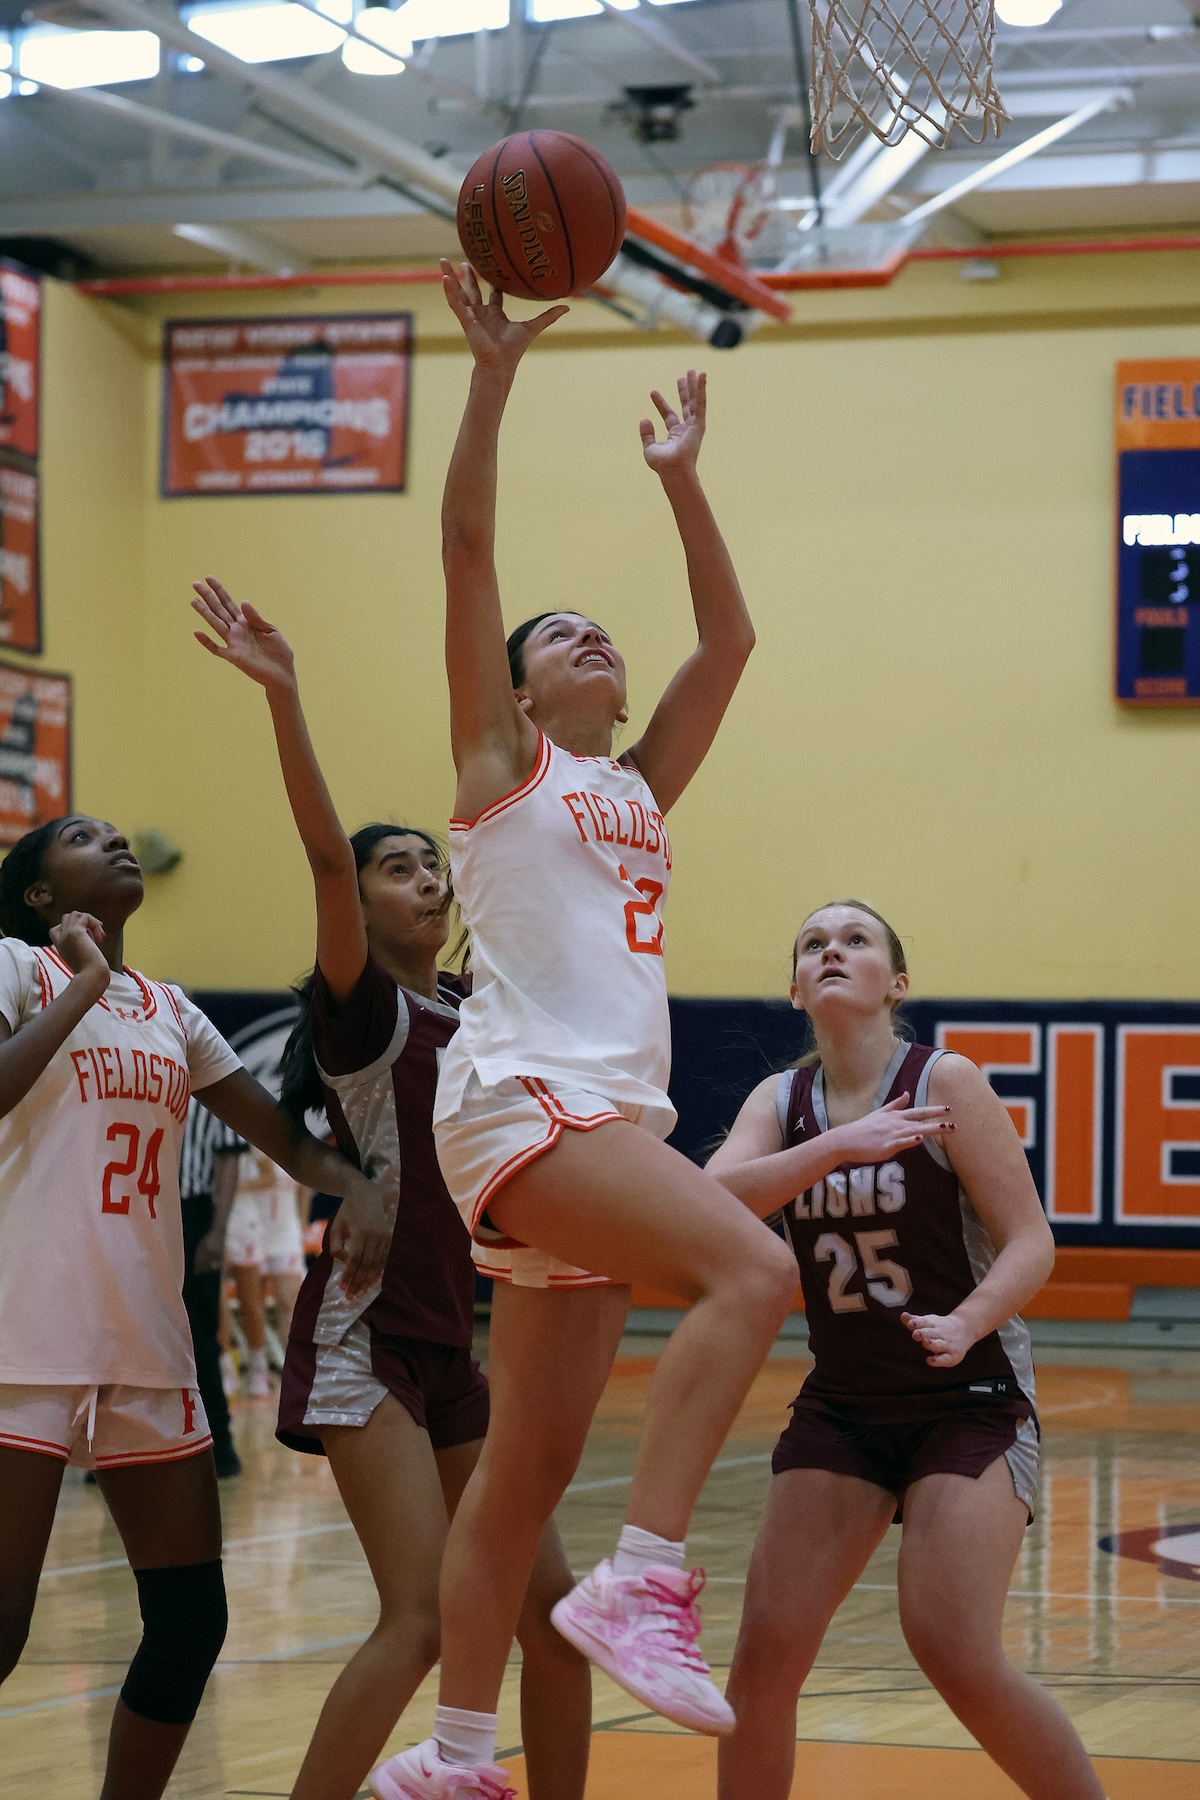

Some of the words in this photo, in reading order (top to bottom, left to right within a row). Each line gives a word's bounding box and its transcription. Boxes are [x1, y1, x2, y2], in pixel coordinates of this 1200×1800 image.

[501, 169, 557, 279] SPALDING
[184, 398, 391, 441] CHAMPIONS
[102, 1122, 164, 1219] 24
[794, 1161, 907, 1220] LIONS
[814, 1229, 914, 1314] 25
[997, 1383, 1006, 1392] M
